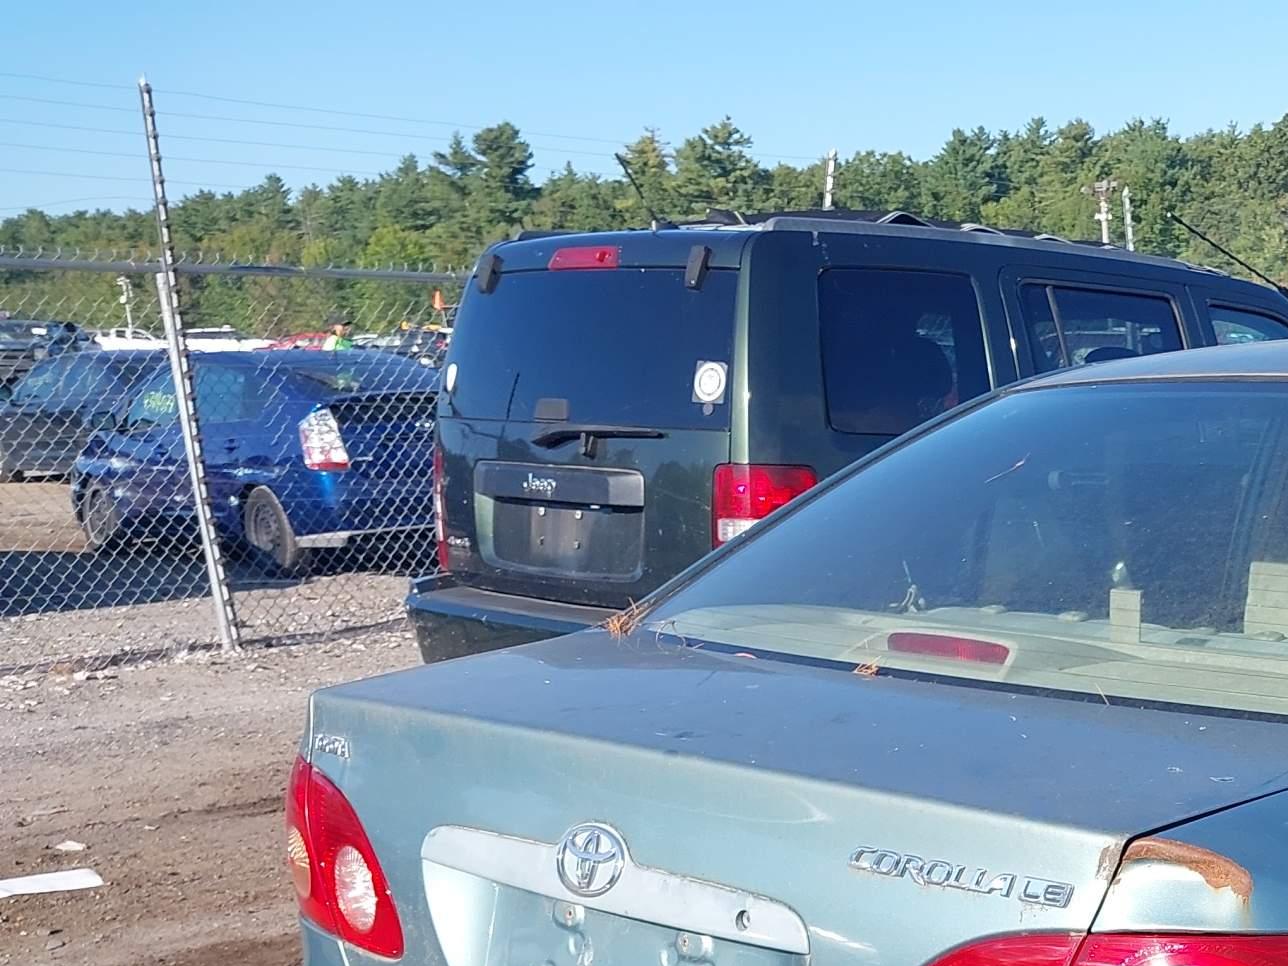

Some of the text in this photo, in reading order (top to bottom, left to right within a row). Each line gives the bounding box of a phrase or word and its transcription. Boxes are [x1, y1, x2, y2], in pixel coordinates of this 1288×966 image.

[522, 472, 557, 497] Jeep
[849, 846, 1074, 908] COROLLA LE
